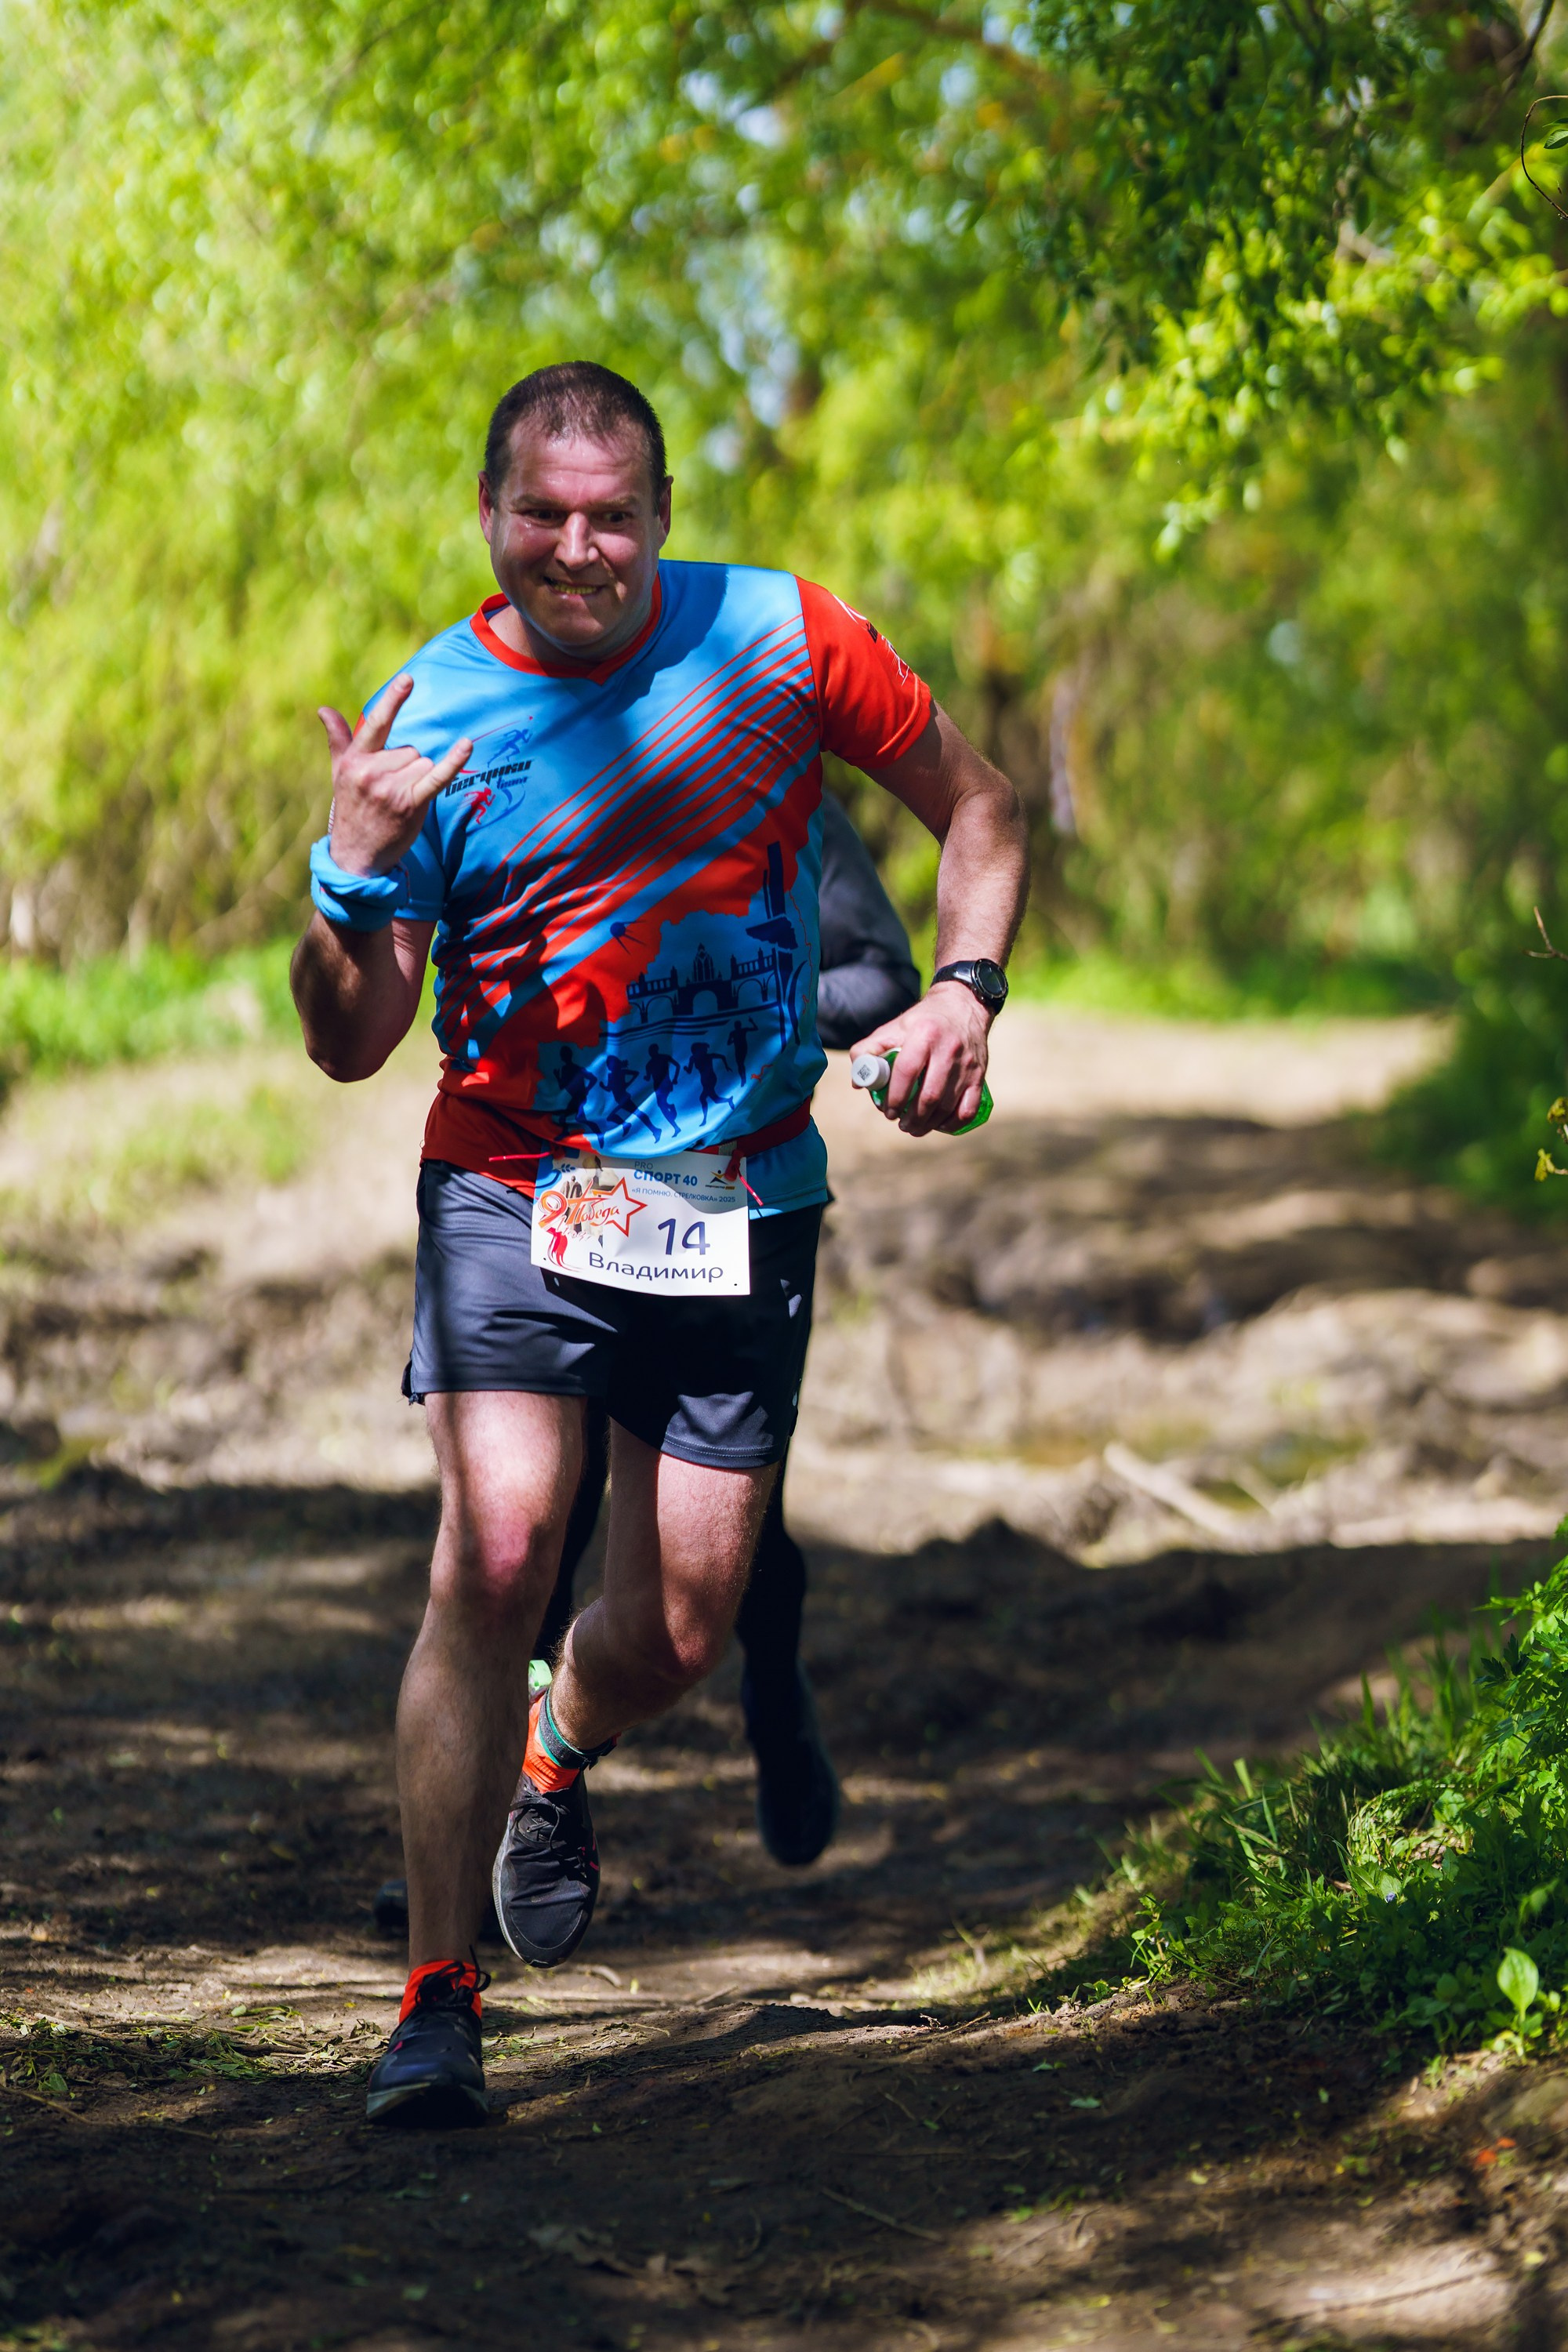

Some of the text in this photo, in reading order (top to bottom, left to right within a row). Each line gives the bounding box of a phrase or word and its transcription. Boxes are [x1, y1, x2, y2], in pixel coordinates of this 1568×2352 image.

[634, 1160, 653, 1170] PRO
[633, 1169, 698, 1186] СПОРТ 40
[642, 1188, 673, 1197] ПОМНЮ.
[657, 1218, 711, 1256] 14
[588, 1250, 724, 1283] Владимир
